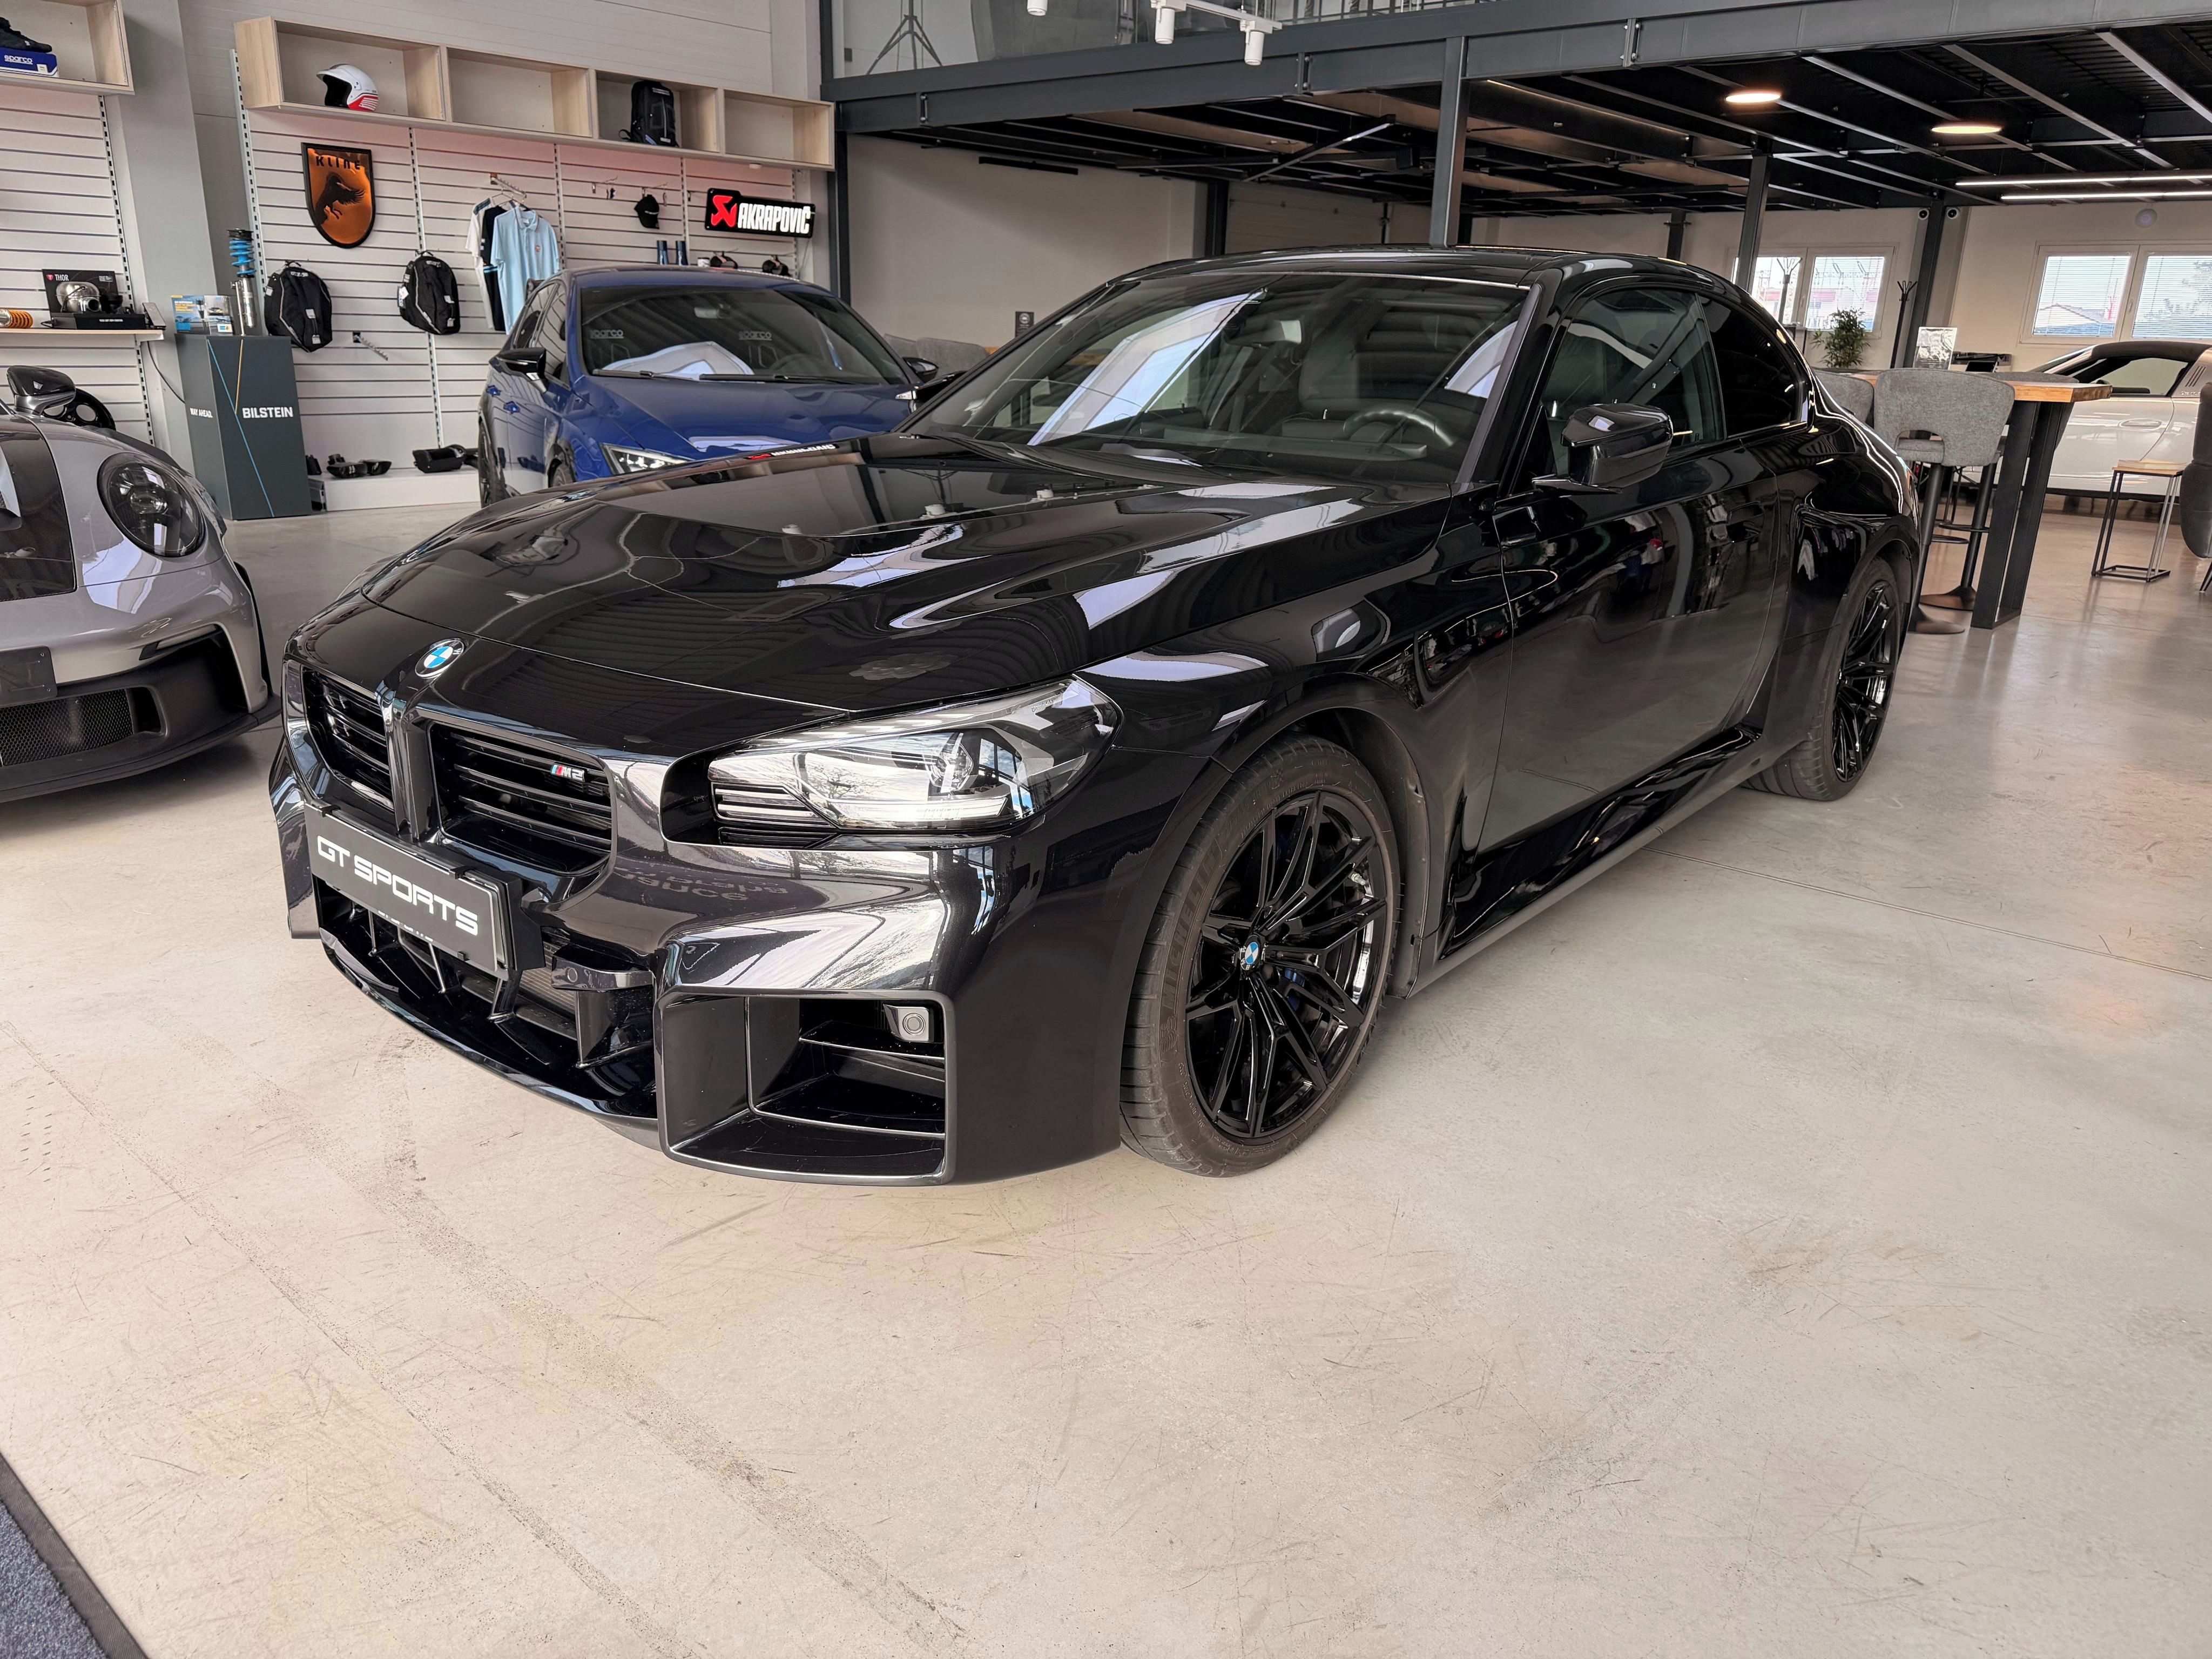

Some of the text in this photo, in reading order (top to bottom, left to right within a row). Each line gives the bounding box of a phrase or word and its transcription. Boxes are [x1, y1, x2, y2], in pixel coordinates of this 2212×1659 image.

[4, 55, 33, 64] sparco
[242, 407, 293, 419] BILSTEIN
[318, 835, 350, 867] GT
[354, 854, 478, 936] SPORTS
[1162, 842, 1219, 1010] MICHELIN
